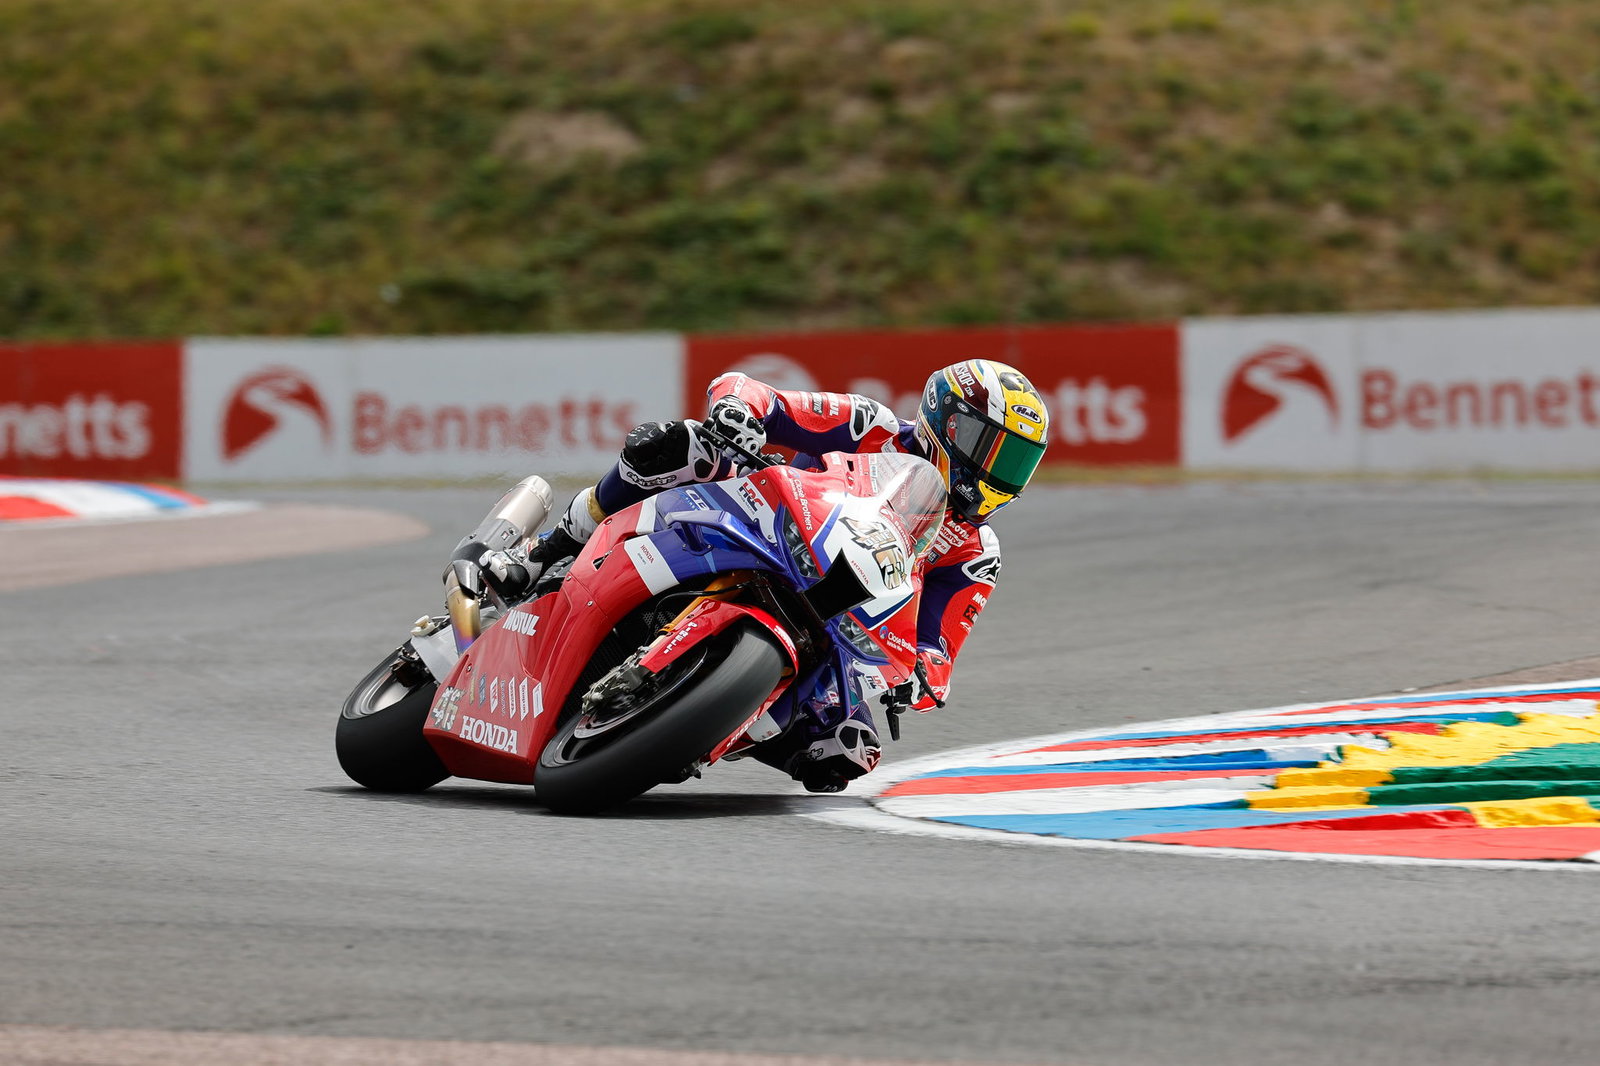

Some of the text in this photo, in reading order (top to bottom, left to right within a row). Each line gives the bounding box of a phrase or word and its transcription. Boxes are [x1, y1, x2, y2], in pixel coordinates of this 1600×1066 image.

[1016, 407, 1039, 421] HJC
[739, 482, 764, 512] HRC
[795, 478, 814, 531] Close Brothers
[894, 521, 914, 556] Bennetts
[641, 544, 654, 564] HONDA
[851, 559, 869, 585] HONDA
[502, 610, 540, 637] MOTUL
[459, 715, 518, 754] HONDA
